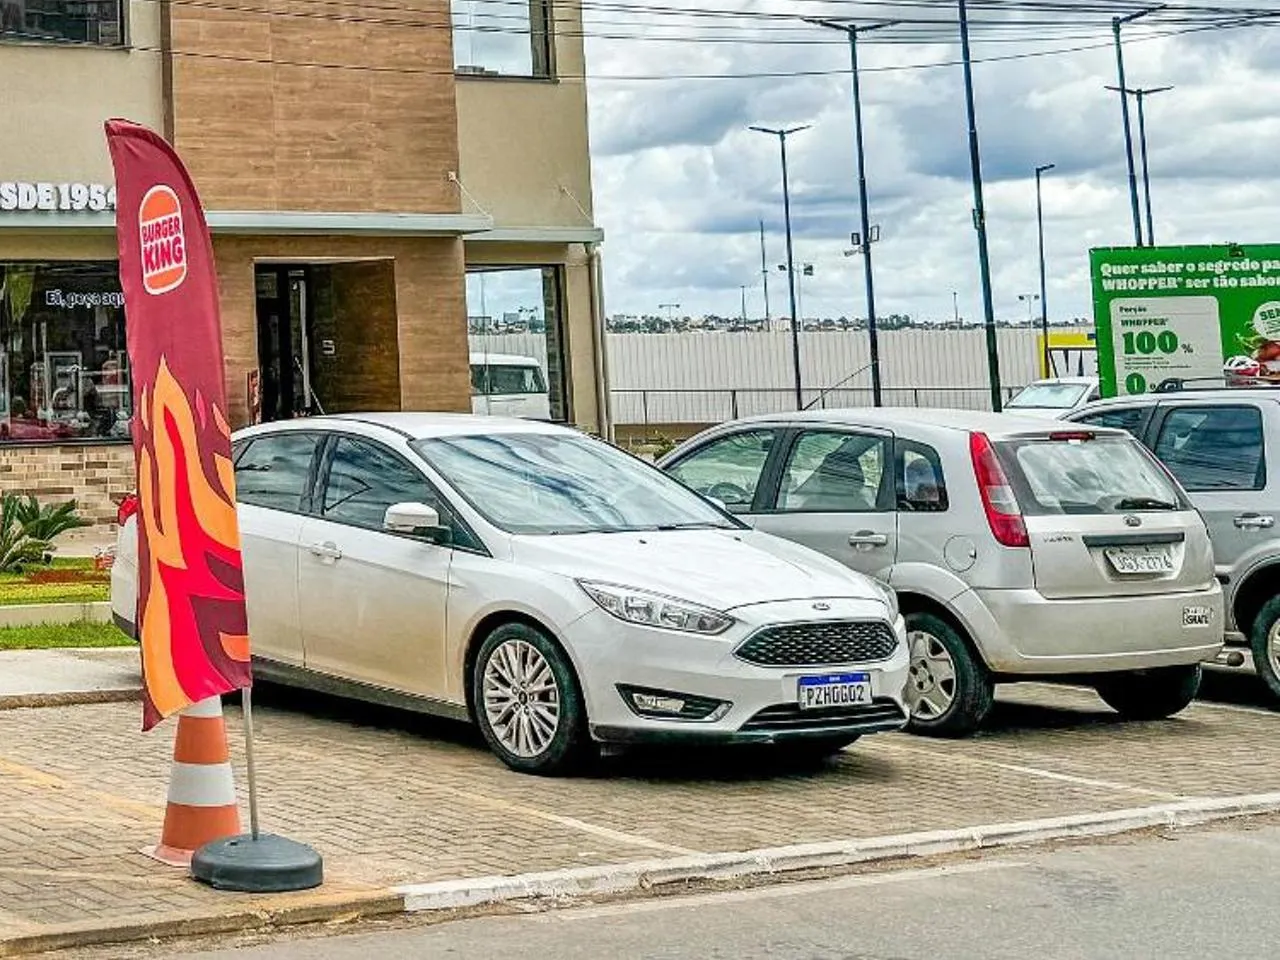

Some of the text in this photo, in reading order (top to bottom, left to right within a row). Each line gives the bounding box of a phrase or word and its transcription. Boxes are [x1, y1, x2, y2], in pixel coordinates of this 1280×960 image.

[141, 215, 181, 242] BURGER
[143, 236, 184, 274] KING
[1100, 263, 1139, 277] Quer
[1141, 261, 1184, 274] saber
[1186, 263, 1196, 273] o
[1198, 258, 1260, 274] segredo
[1185, 278, 1211, 288] ser
[1213, 275, 1238, 288] tão
[1122, 330, 1178, 355] 100
